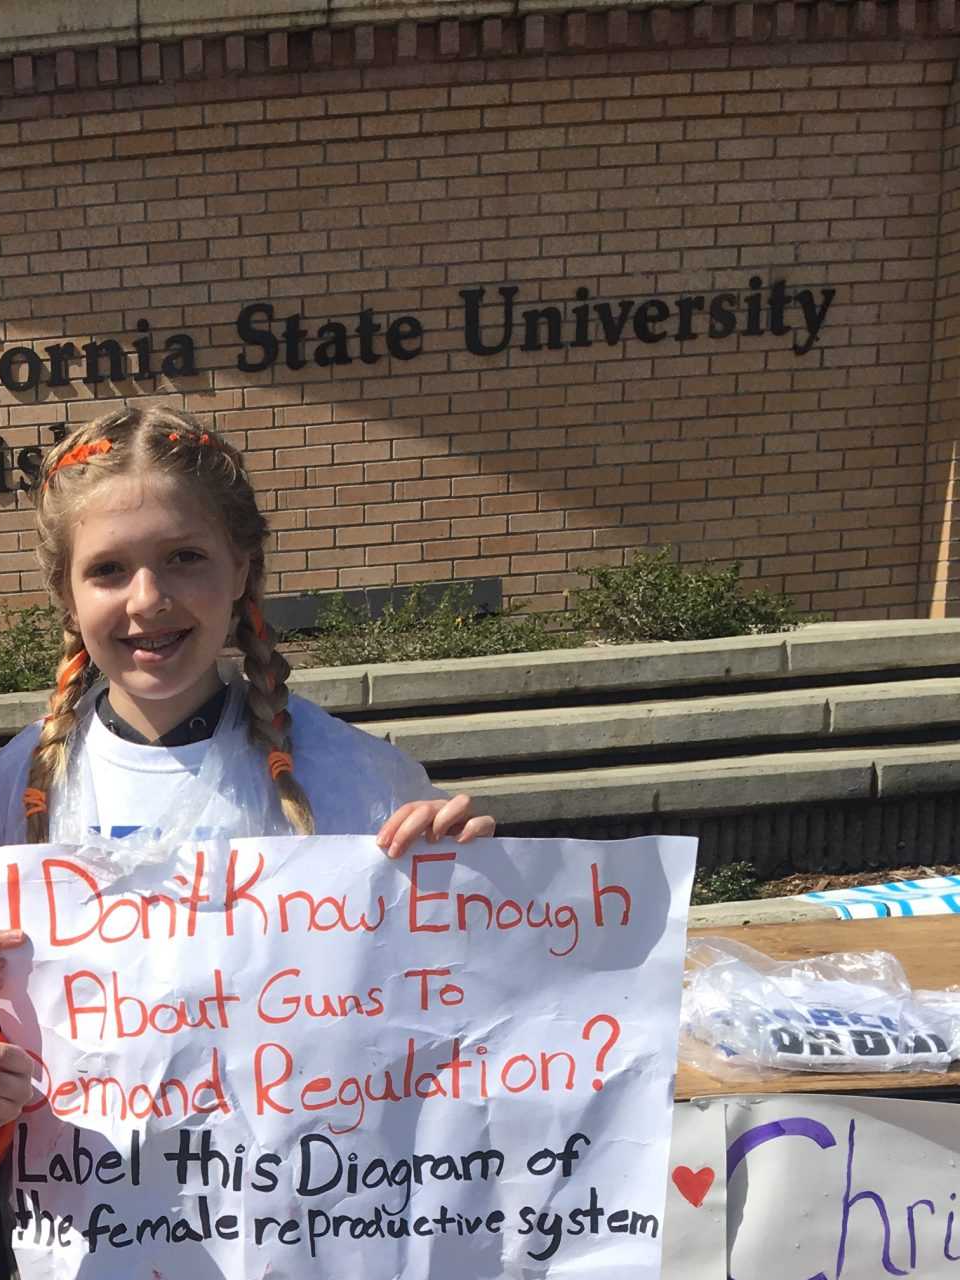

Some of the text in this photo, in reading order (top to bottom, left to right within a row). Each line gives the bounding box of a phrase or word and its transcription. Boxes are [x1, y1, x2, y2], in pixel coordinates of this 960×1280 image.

[238, 302, 423, 374] State
[458, 274, 837, 357] University
[42, 848, 210, 947] Don't
[224, 848, 386, 937] Know
[409, 850, 632, 957] Enough
[63, 967, 465, 1040] About Guns To
[253, 1013, 621, 1135] Regulation?
[17, 1122, 590, 1217] Label this Diagram of
[13, 1187, 660, 1261] the female reproductive system
